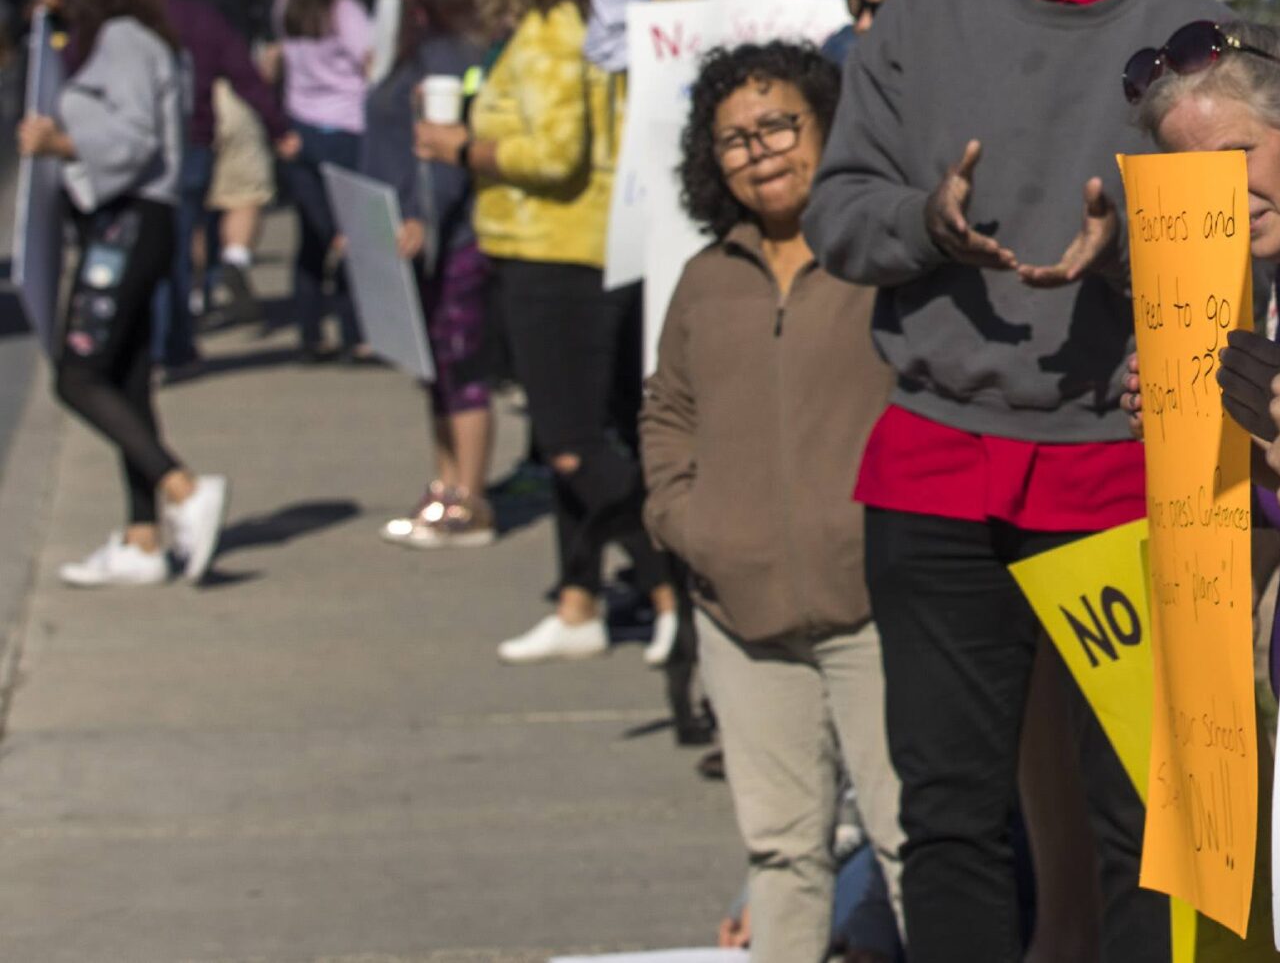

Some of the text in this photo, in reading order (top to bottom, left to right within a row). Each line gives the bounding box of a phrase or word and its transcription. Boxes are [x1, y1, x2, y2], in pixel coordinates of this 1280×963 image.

[1203, 187, 1236, 239] and
[1174, 276, 1193, 330] to
[1206, 294, 1232, 353] go
[1058, 584, 1143, 669] NO
